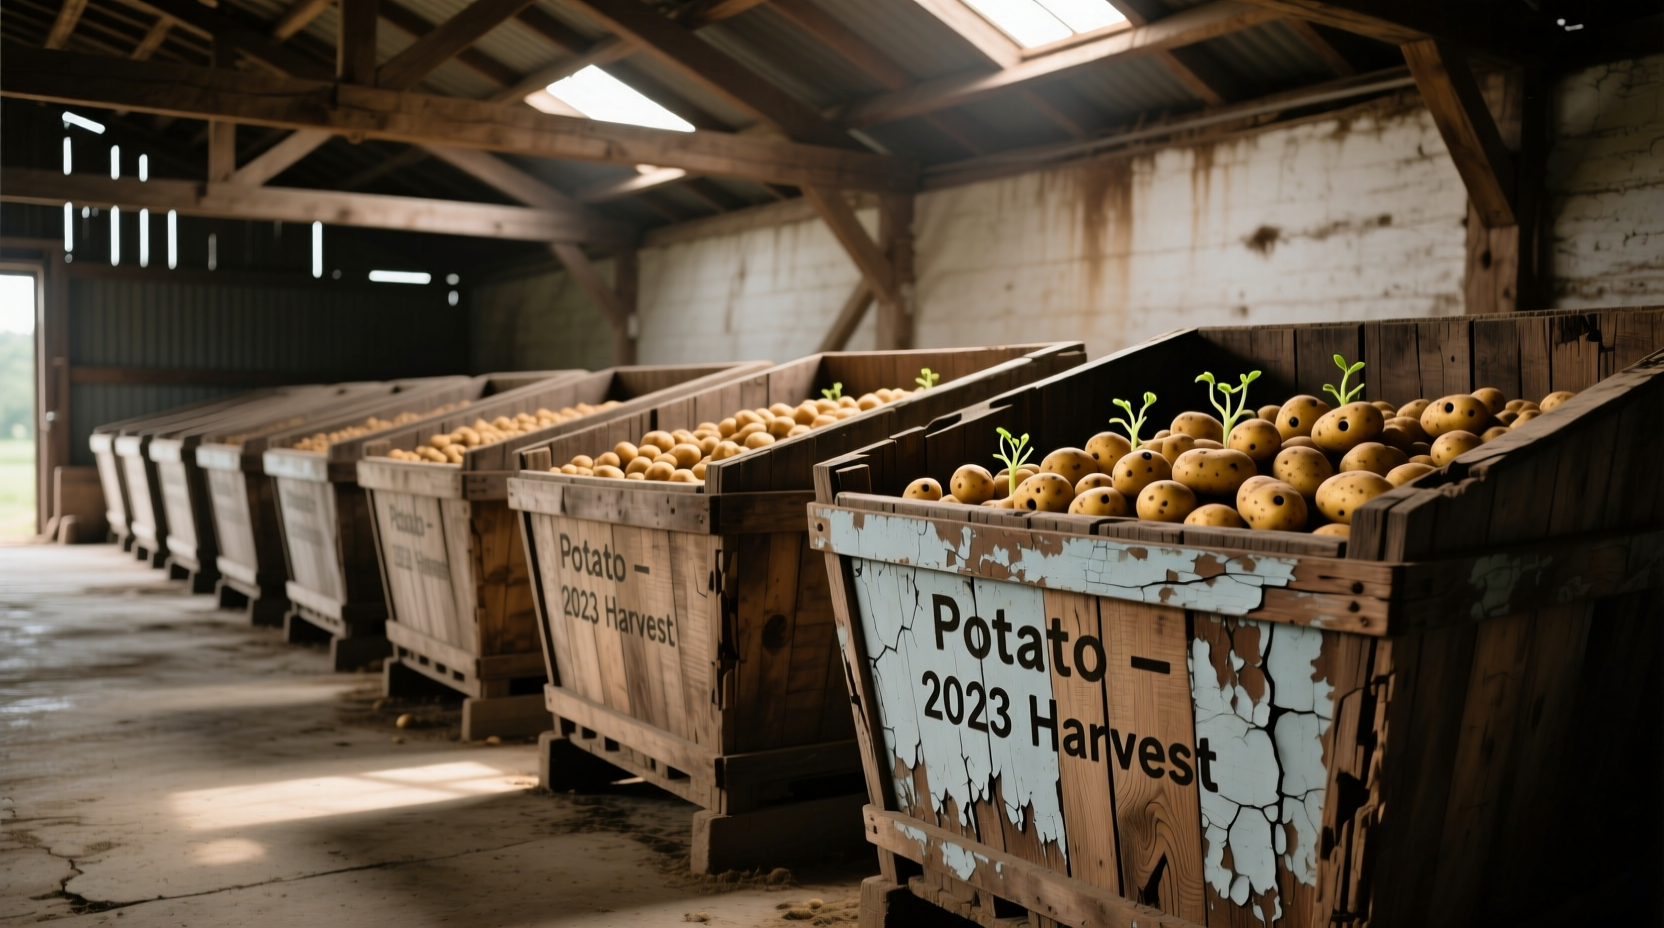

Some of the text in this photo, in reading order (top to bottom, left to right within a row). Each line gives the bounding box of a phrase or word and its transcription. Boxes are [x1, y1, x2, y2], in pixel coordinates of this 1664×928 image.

[559, 533, 626, 582] Potato
[562, 585, 675, 648] 2023 Harvest
[932, 594, 1107, 682] Potato
[921, 670, 1219, 793] 2023 Harvest
